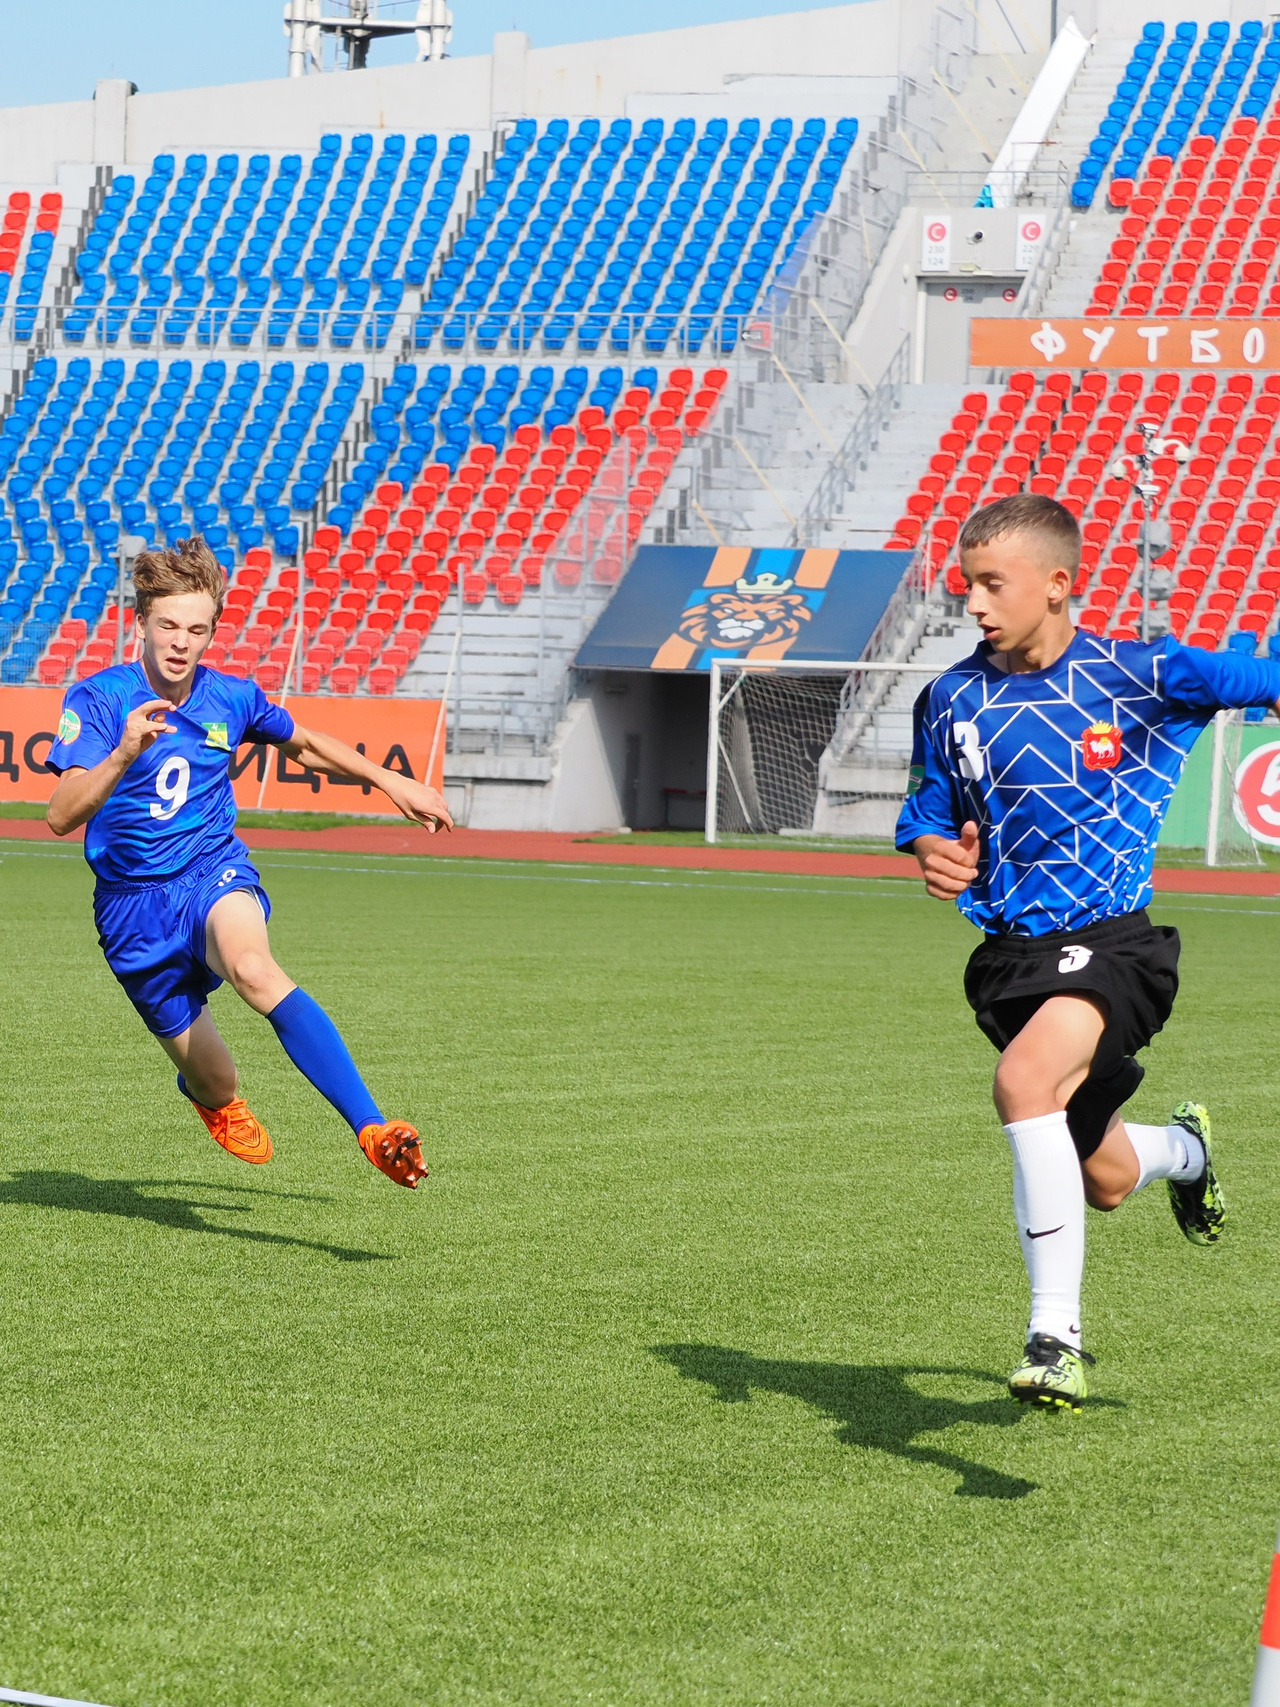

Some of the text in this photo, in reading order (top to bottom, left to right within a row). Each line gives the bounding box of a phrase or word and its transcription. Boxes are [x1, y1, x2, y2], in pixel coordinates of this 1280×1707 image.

[953, 721, 984, 781] 3
[150, 756, 190, 820] 9
[1057, 945, 1094, 974] 3
